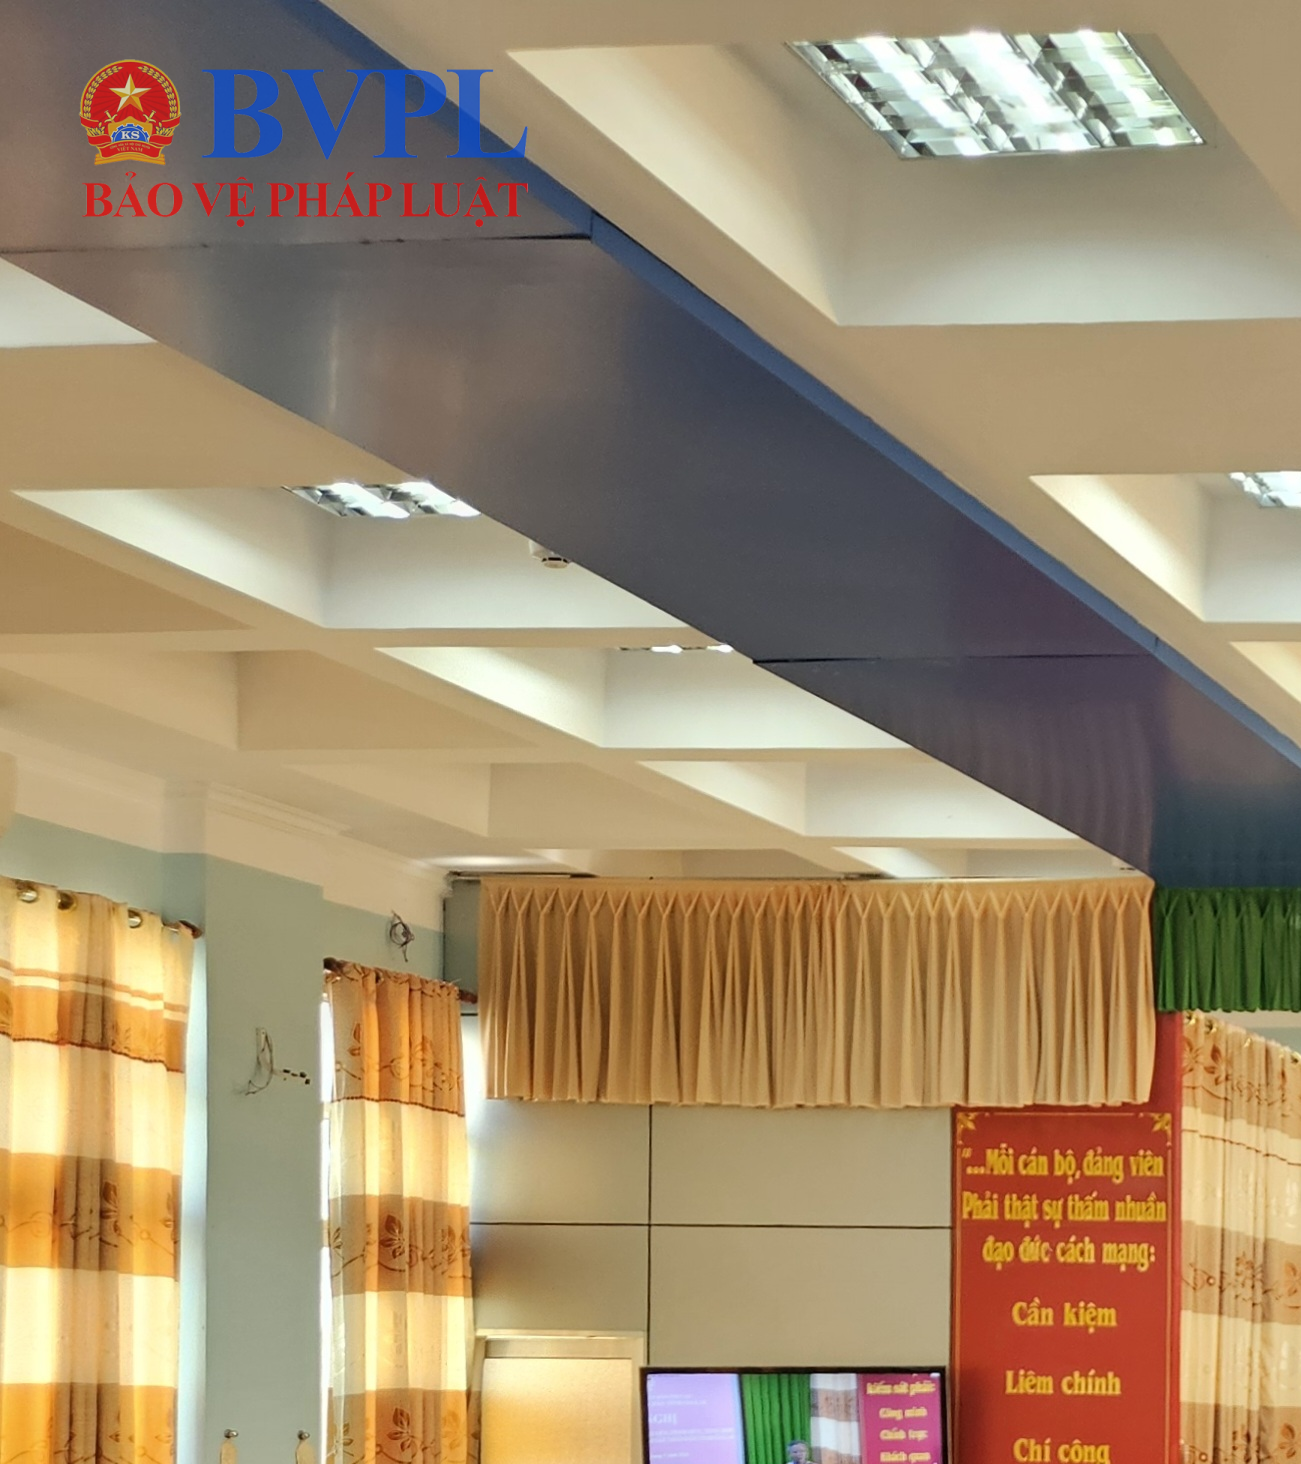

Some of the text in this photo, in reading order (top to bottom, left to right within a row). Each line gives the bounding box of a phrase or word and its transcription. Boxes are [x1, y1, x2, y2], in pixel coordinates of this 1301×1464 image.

[1018, 1146, 1049, 1176] cán
[1082, 1146, 1124, 1184] đảng
[1130, 1150, 1164, 1177] viên
[962, 1191, 1166, 1228] Phải thật sự thấm nhuần
[982, 1235, 1156, 1272] đạo đức cách mạng:
[1011, 1297, 1118, 1334] Cần kiệm
[1005, 1368, 1121, 1395] Liêm chính
[1013, 1437, 1051, 1462] Chí
